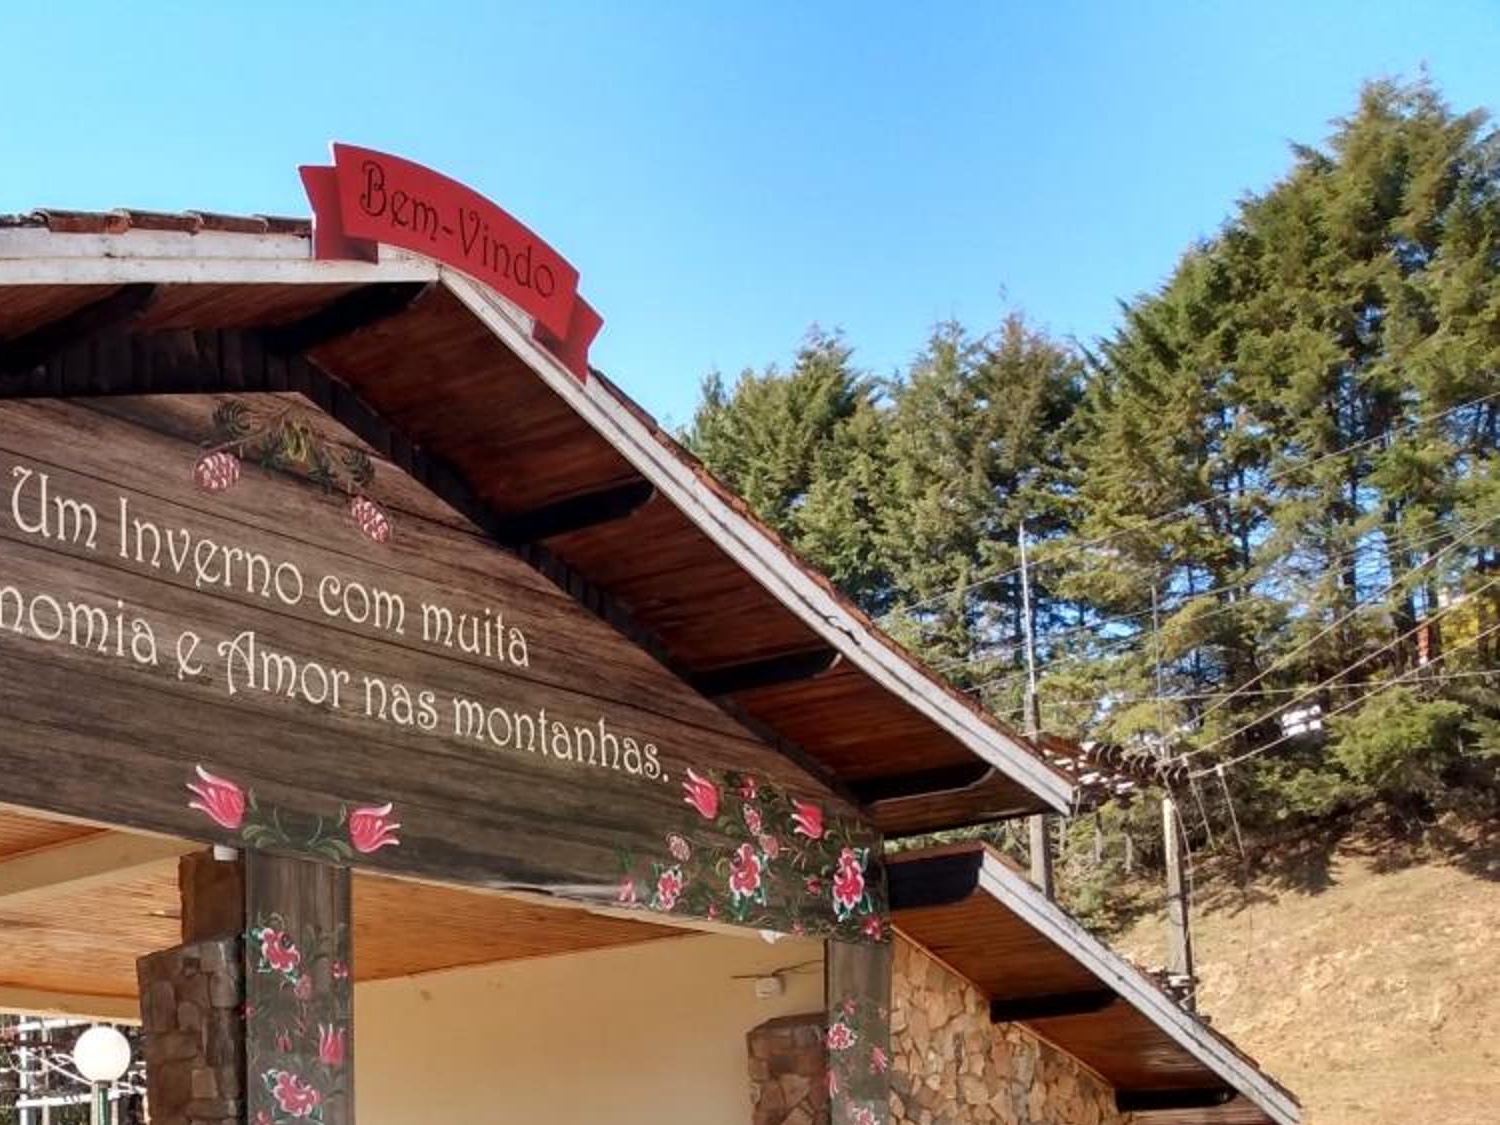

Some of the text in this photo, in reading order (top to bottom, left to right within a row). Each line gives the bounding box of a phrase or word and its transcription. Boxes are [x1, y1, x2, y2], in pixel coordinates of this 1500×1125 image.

[361, 160, 555, 298] Bem-Vindo
[10, 466, 529, 667] Um Inverno com muita
[176, 631, 203, 679] e
[217, 631, 350, 709] Amor
[363, 676, 438, 730] nas
[453, 697, 670, 782] montanhas.
